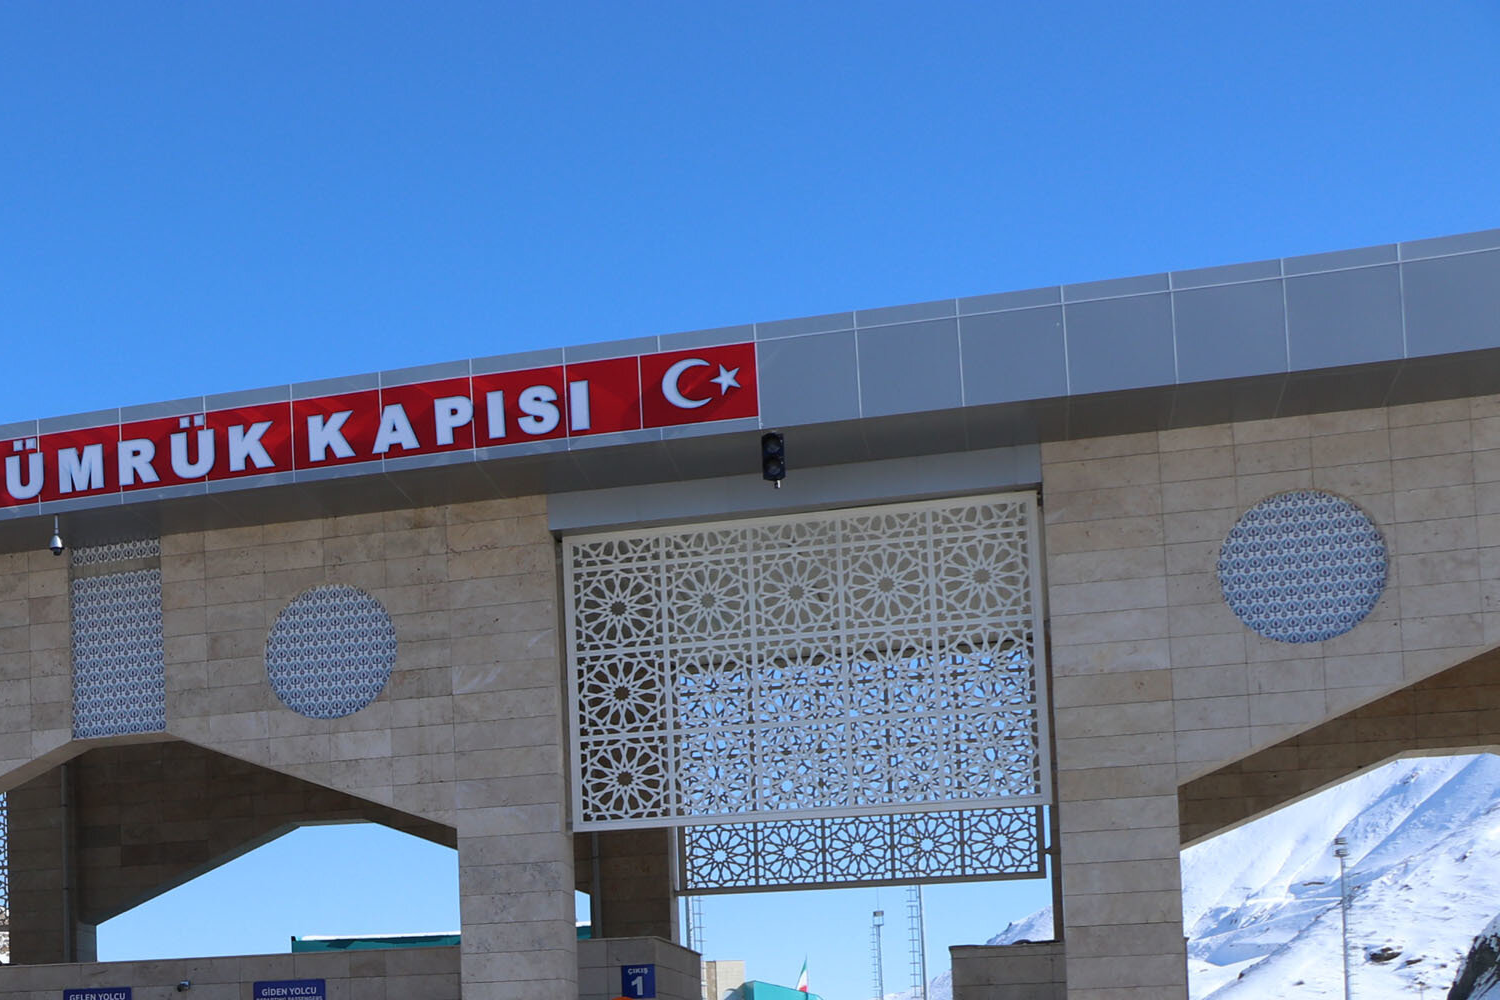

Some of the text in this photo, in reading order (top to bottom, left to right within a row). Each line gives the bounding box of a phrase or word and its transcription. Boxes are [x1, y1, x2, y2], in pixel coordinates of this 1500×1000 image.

[307, 379, 591, 463] KAPISI
[261, 986, 317, 996] GİDEN YOLCU
[631, 976, 644, 996] 1
